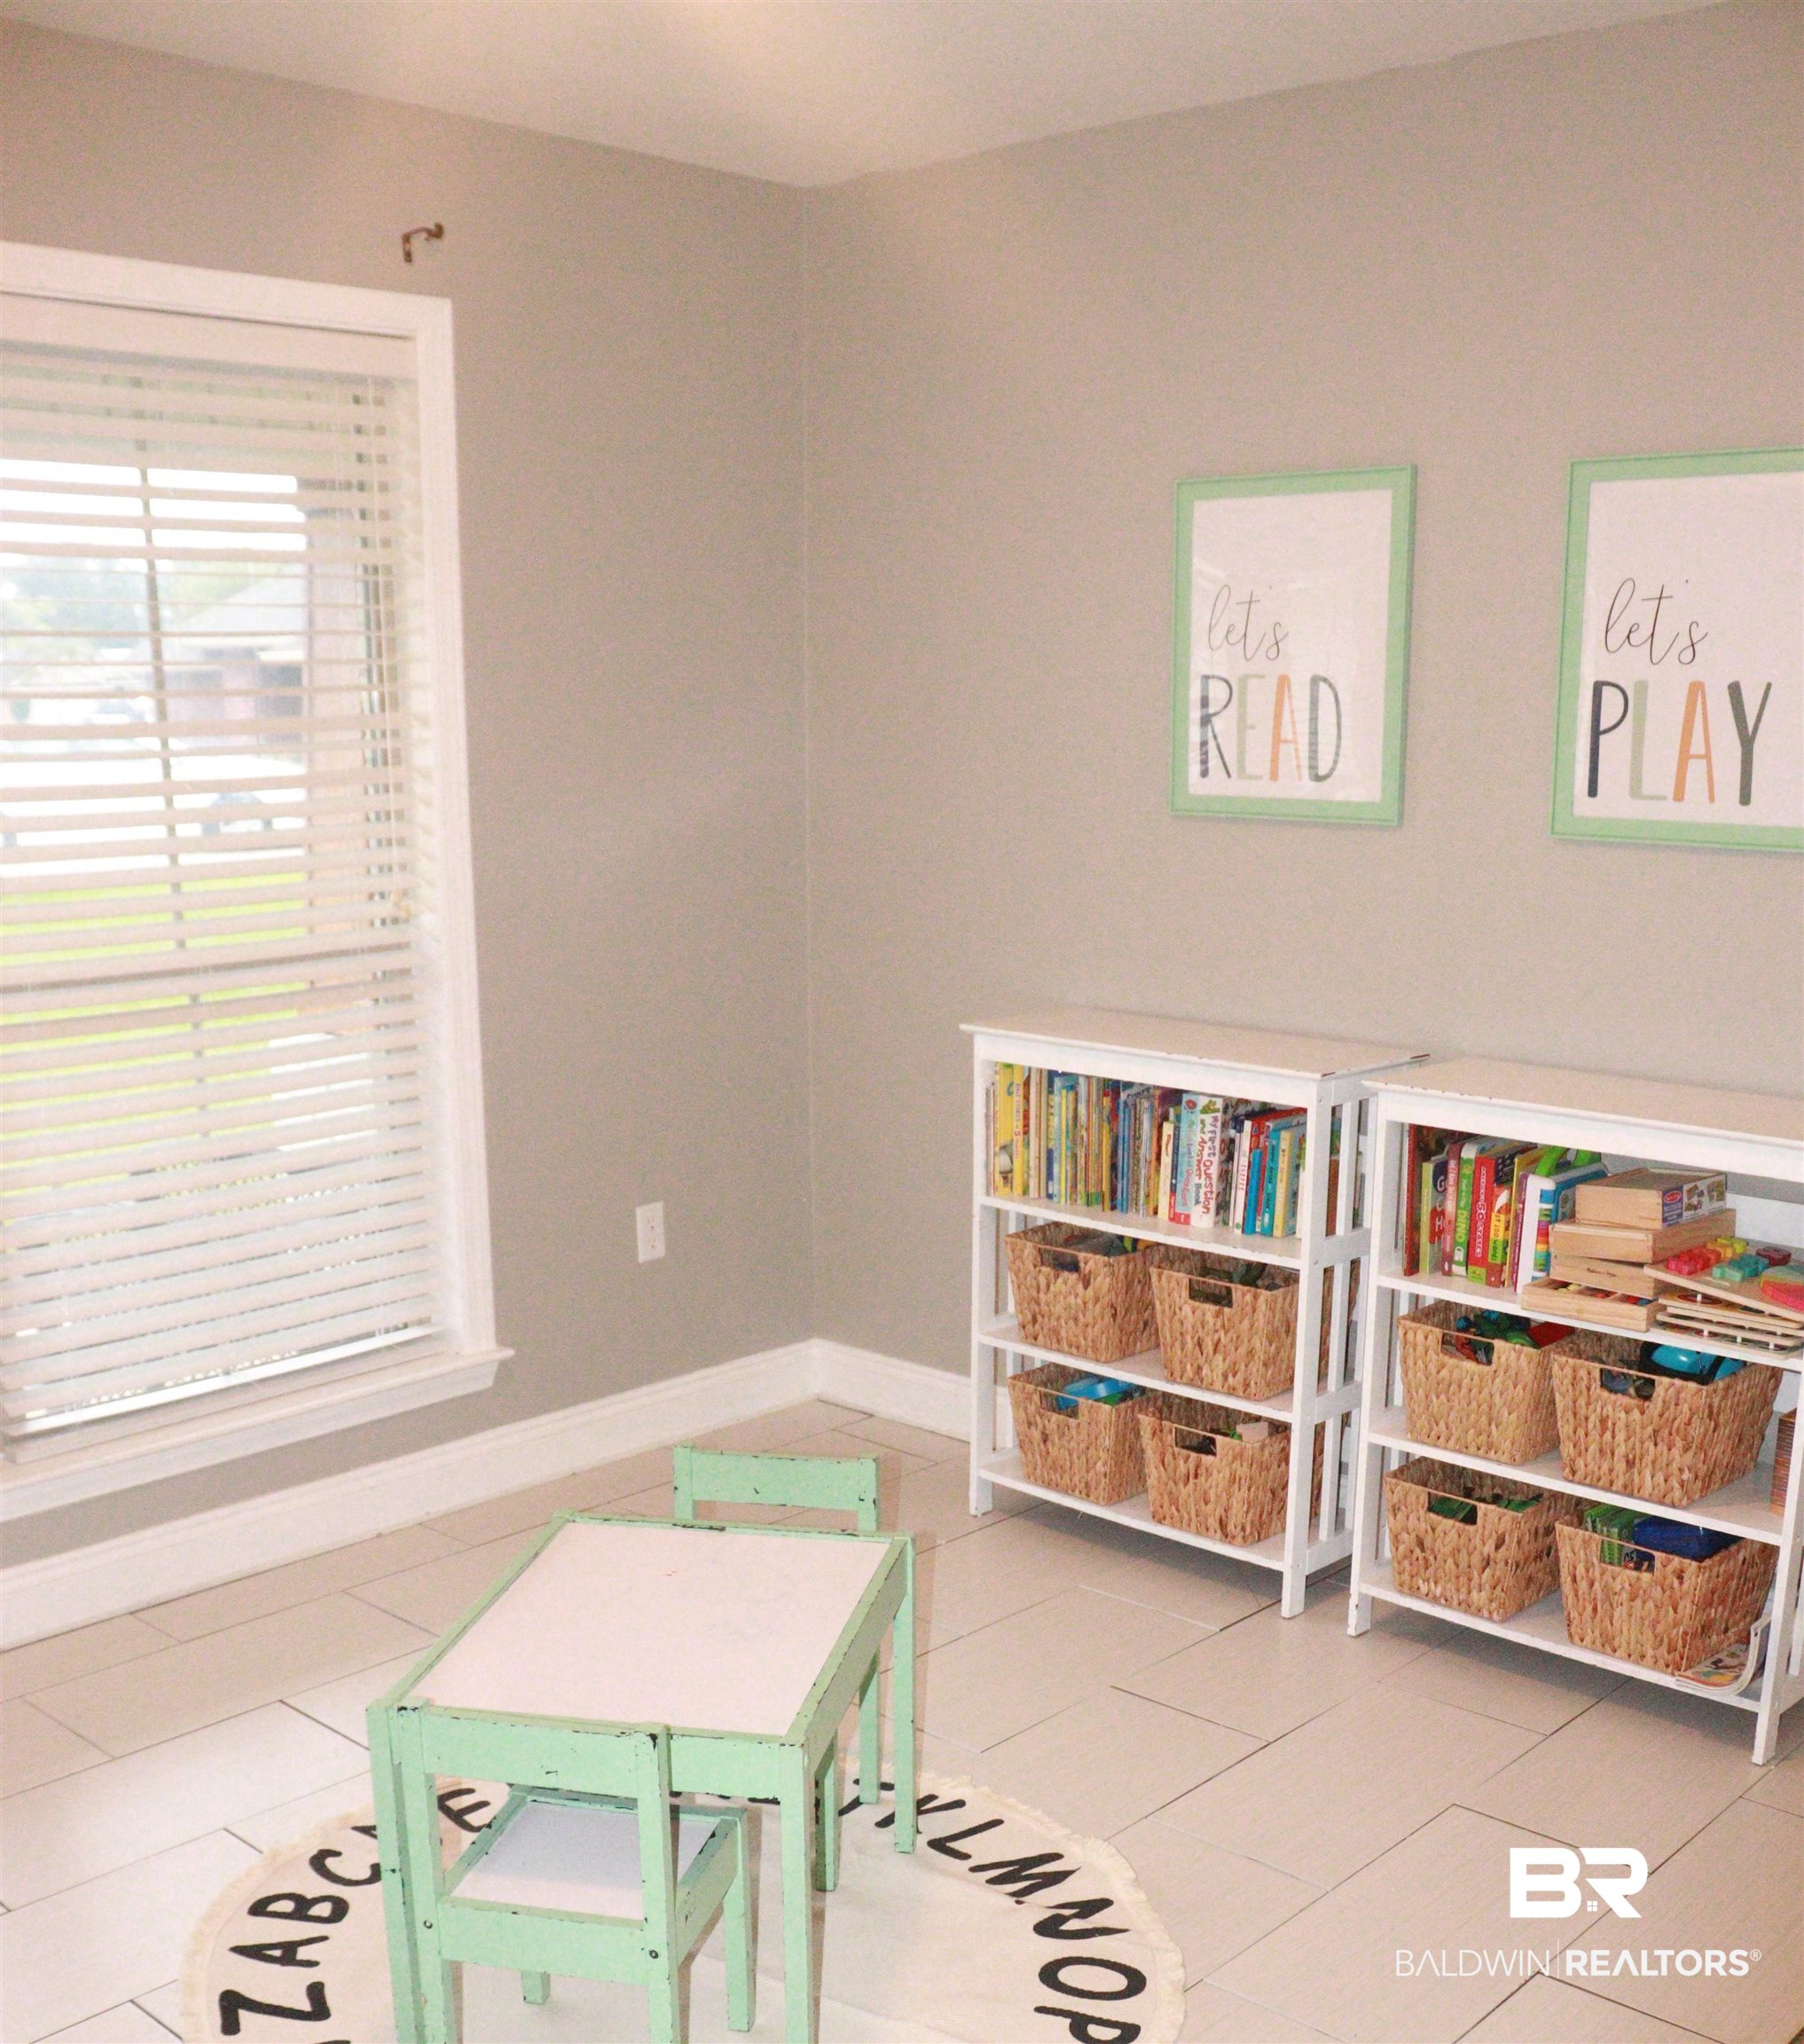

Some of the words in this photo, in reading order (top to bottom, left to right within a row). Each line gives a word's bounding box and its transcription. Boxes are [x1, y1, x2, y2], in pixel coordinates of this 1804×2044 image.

[1208, 584, 1289, 662] let's
[1604, 577, 1708, 665] let's
[1199, 673, 1343, 783] READ
[1587, 679, 1773, 806] PLAY
[1196, 1136, 1207, 1181] Answer
[1207, 1130, 1218, 1158] First
[1202, 1159, 1214, 1215] Question
[1455, 1209, 1468, 1242] DINO
[1476, 1201, 1487, 1222] 50
[1493, 1223, 1502, 1238] 100
[1475, 1222, 1484, 1258] STATES
